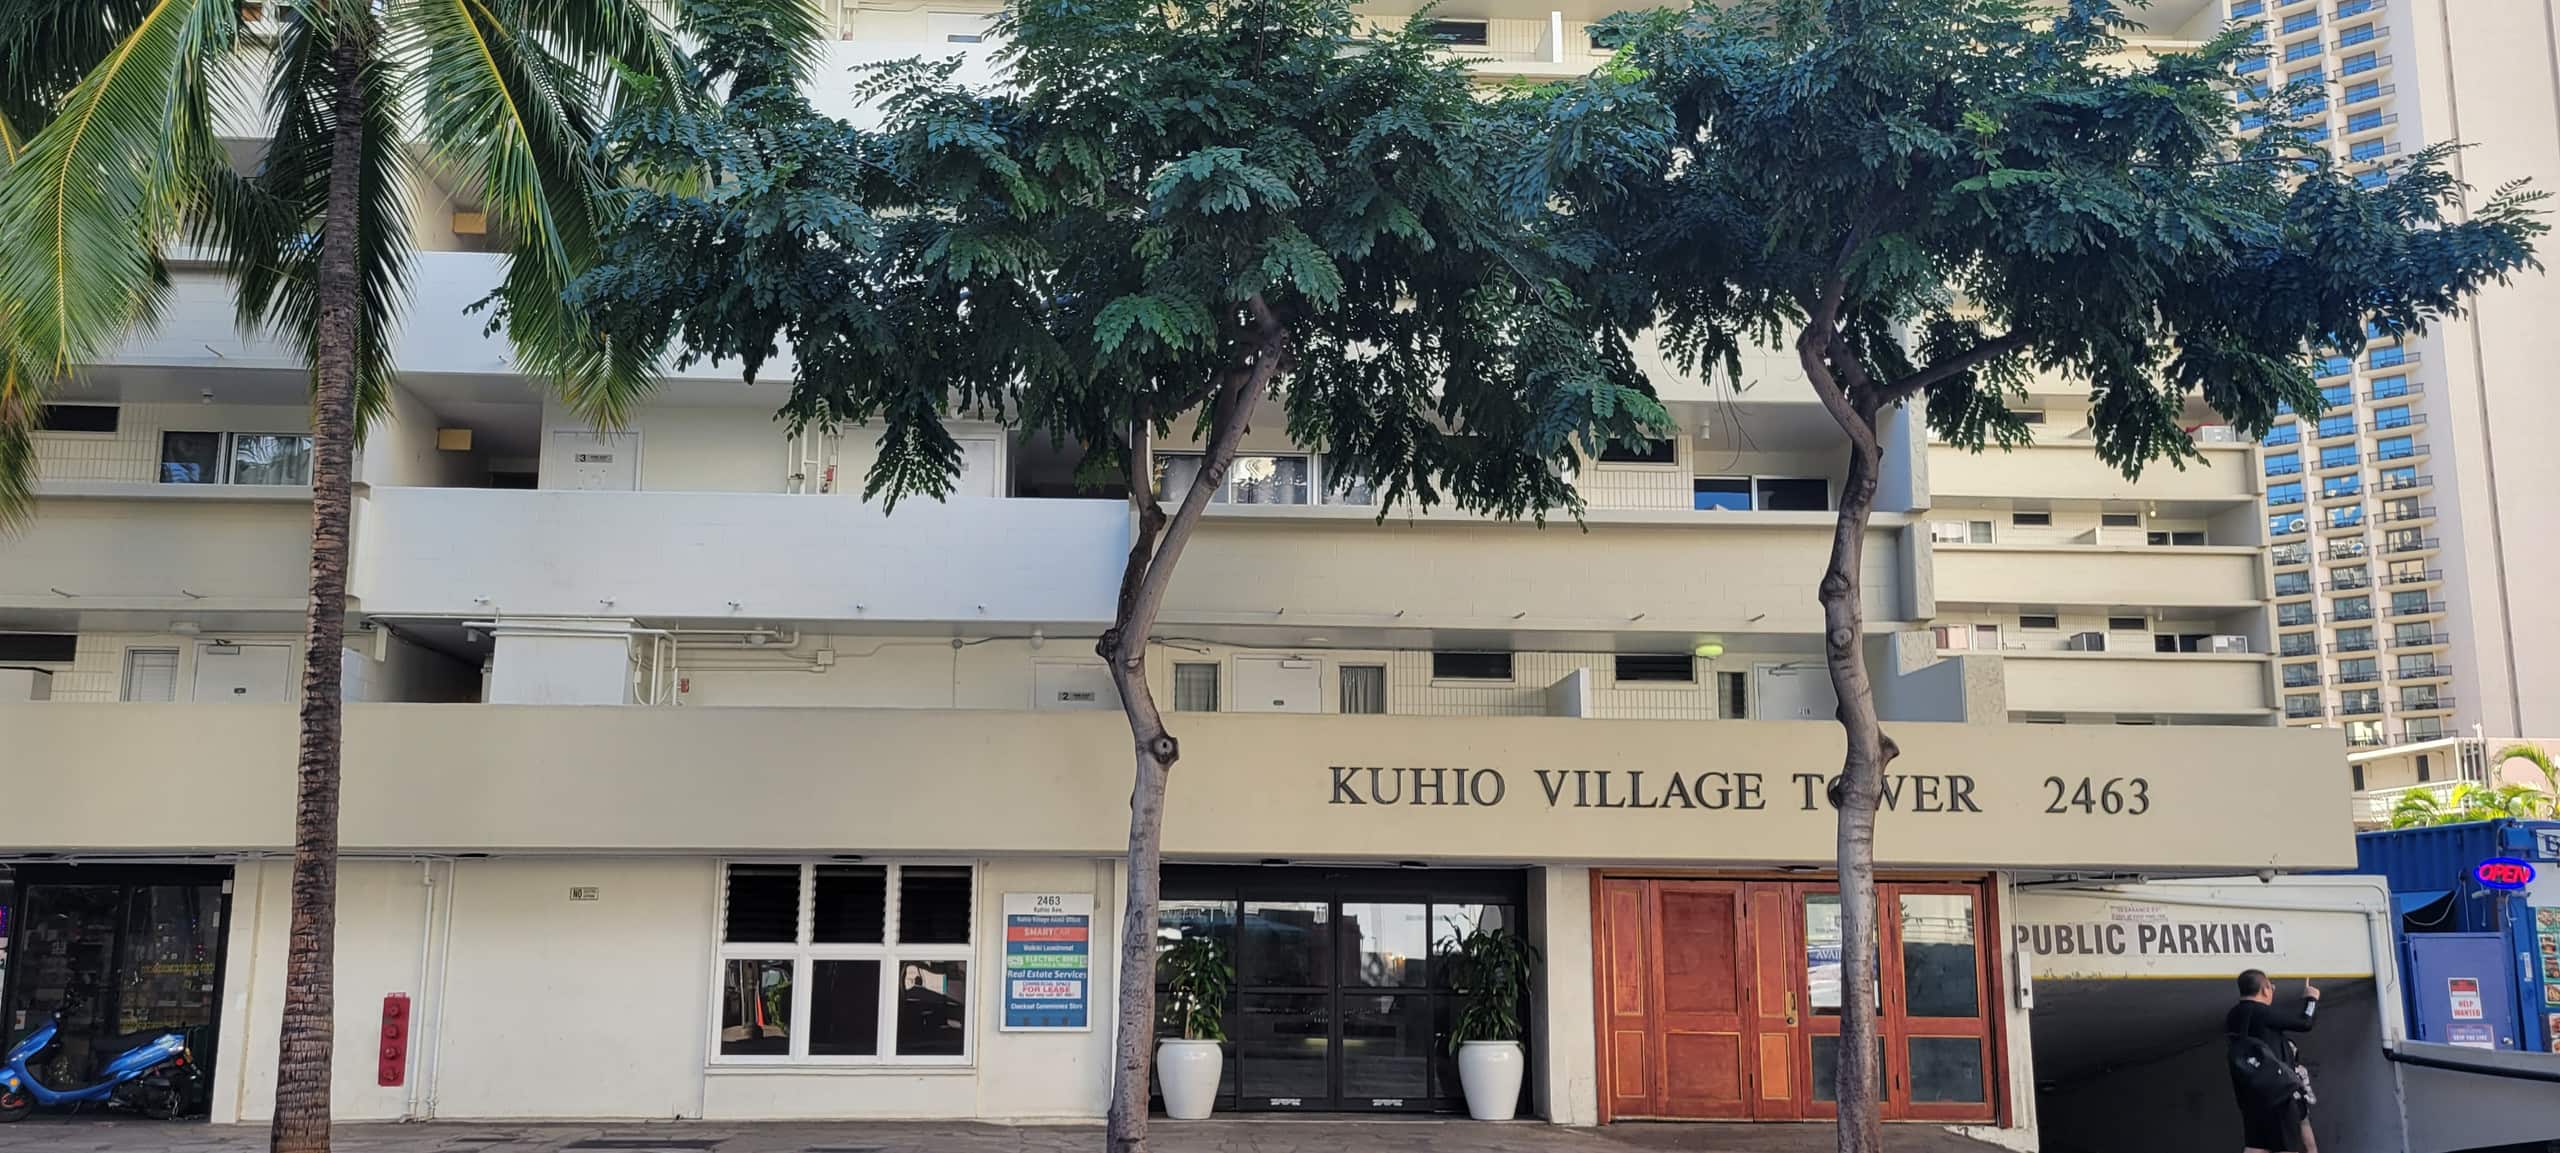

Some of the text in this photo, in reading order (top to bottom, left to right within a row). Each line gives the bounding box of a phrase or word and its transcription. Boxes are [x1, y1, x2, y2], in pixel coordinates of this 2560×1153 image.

[1328, 766, 1506, 808] KUHIO
[1534, 769, 1767, 810] VILLAGE
[2044, 777, 2151, 815] 2463
[2479, 864, 2530, 883] OPEN
[1037, 895, 1061, 906] 2463
[2012, 923, 2275, 955] PUBLIC PARKING
[1008, 970, 1087, 978] Real Estate Services
[2454, 1009, 2480, 1017] WANTED
